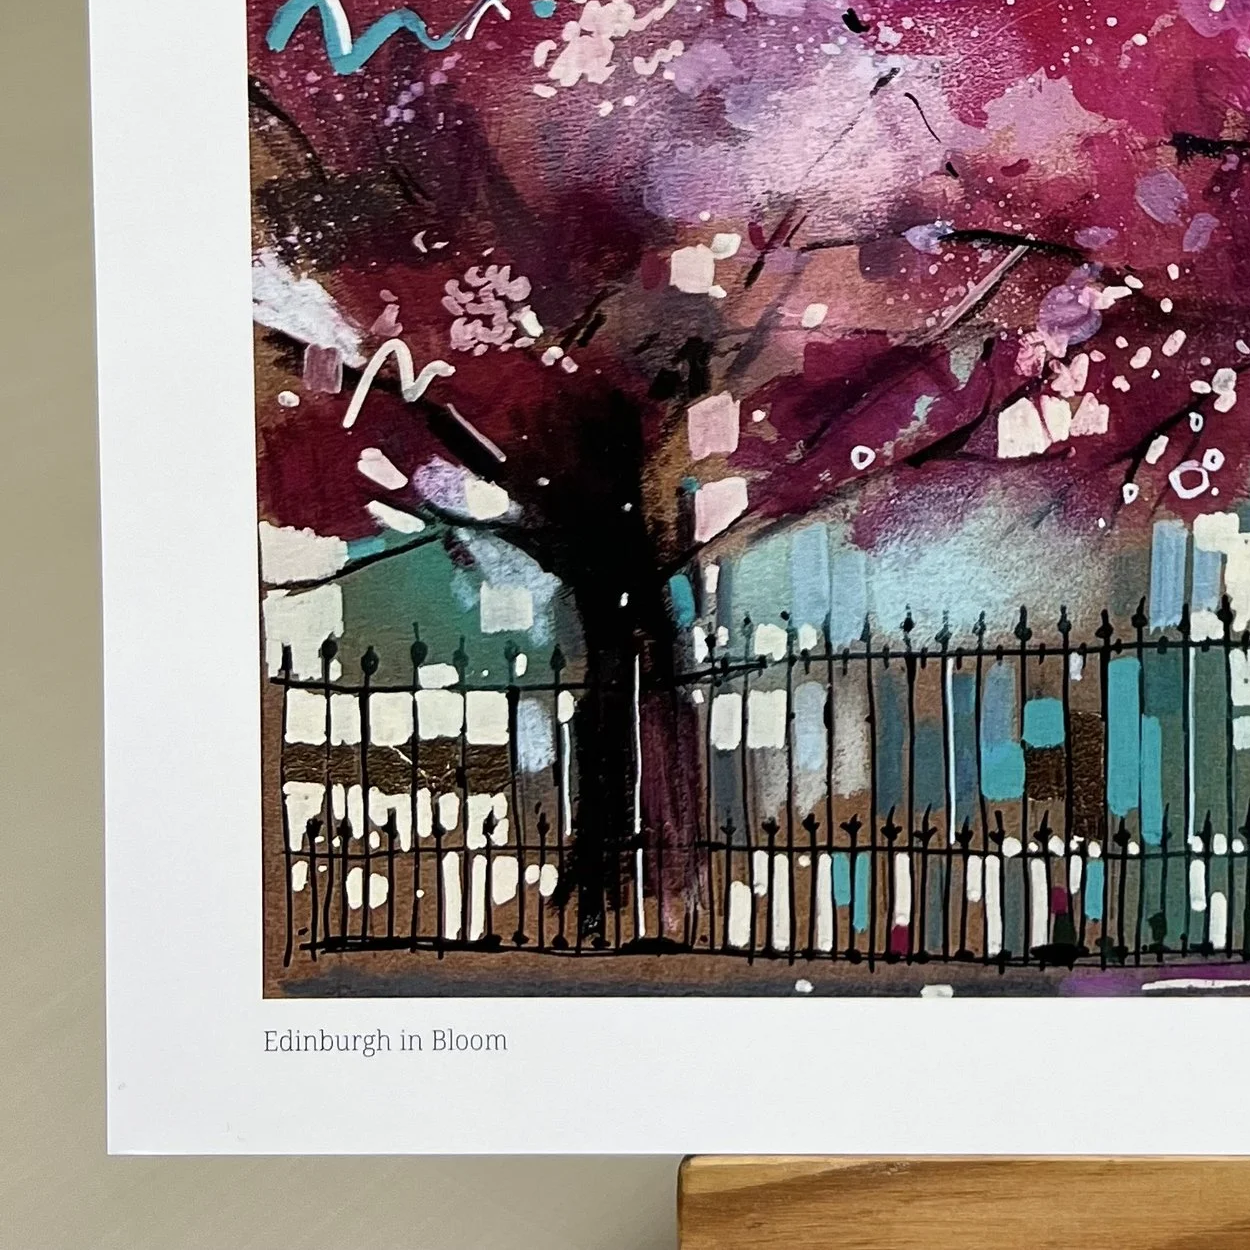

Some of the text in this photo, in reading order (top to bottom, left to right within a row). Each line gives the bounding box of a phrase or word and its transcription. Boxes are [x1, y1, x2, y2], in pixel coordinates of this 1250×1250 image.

[263, 1027, 508, 1058] Edinburgh in Bloom
